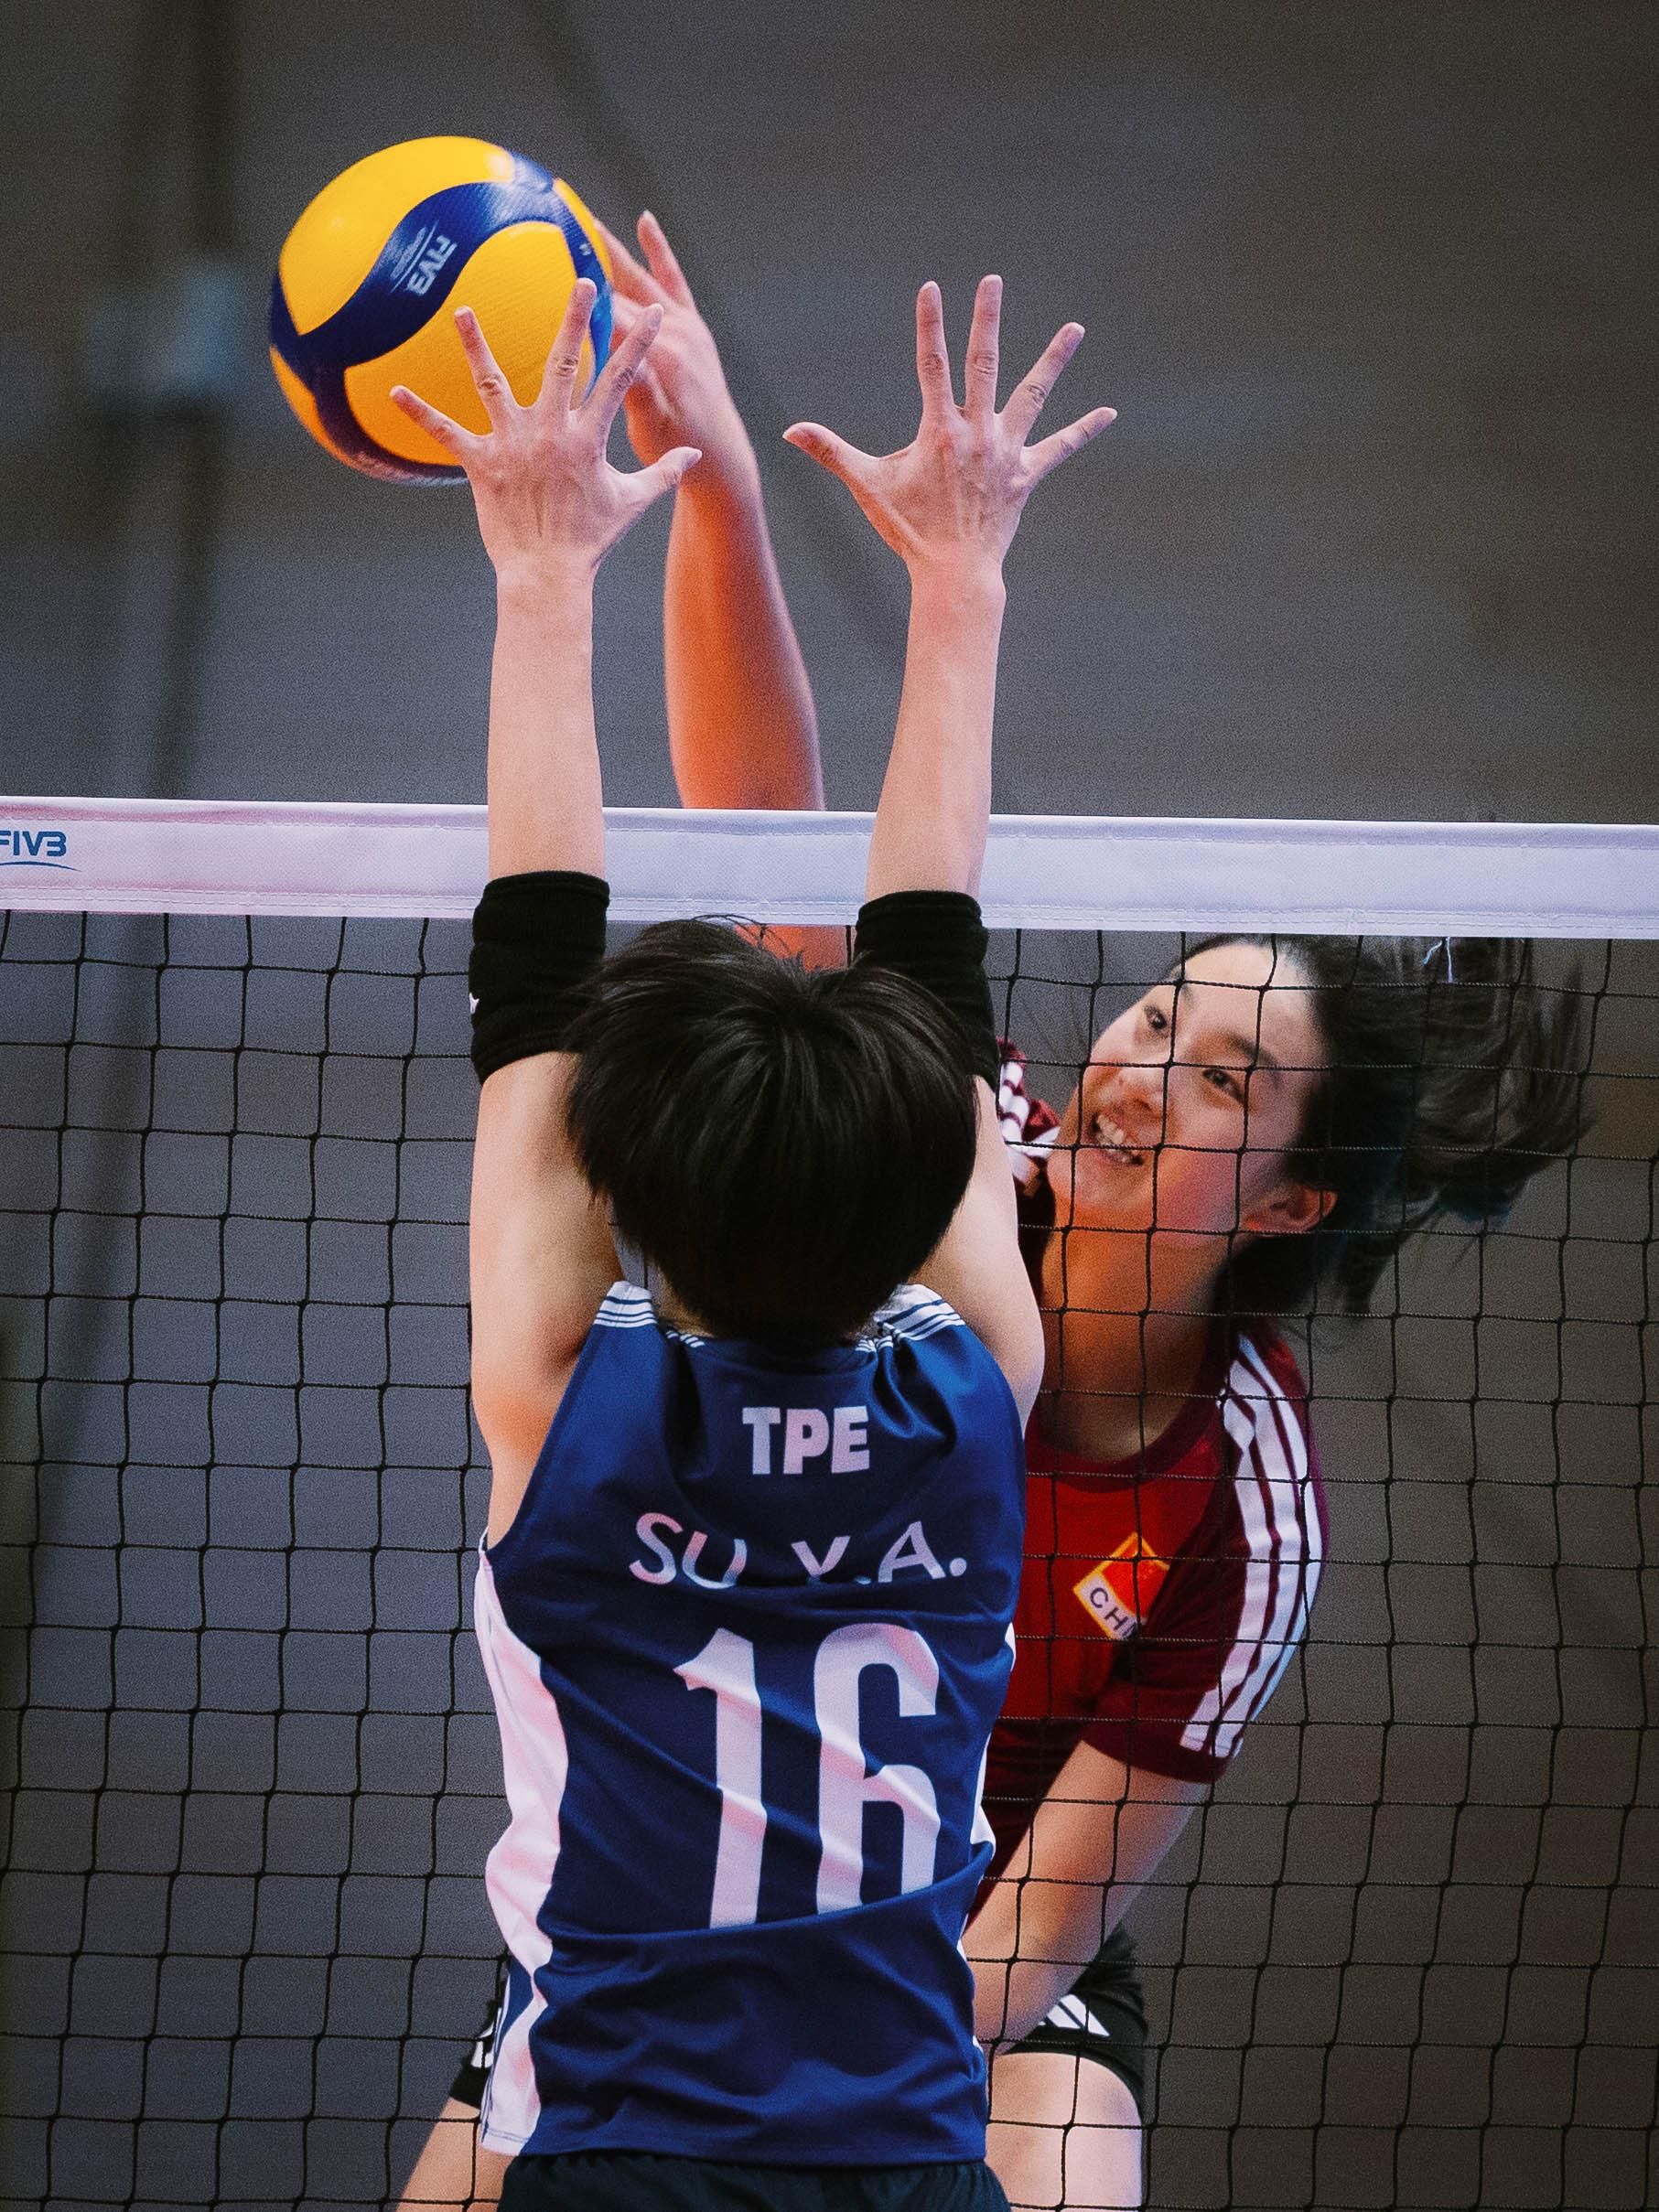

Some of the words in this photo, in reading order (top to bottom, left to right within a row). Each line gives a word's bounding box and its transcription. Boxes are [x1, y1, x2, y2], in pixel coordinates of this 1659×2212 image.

[407, 235, 458, 295] FIVB
[742, 1405, 870, 1475] TPE
[629, 1511, 748, 1590] SU
[673, 1622, 942, 1929] 16
